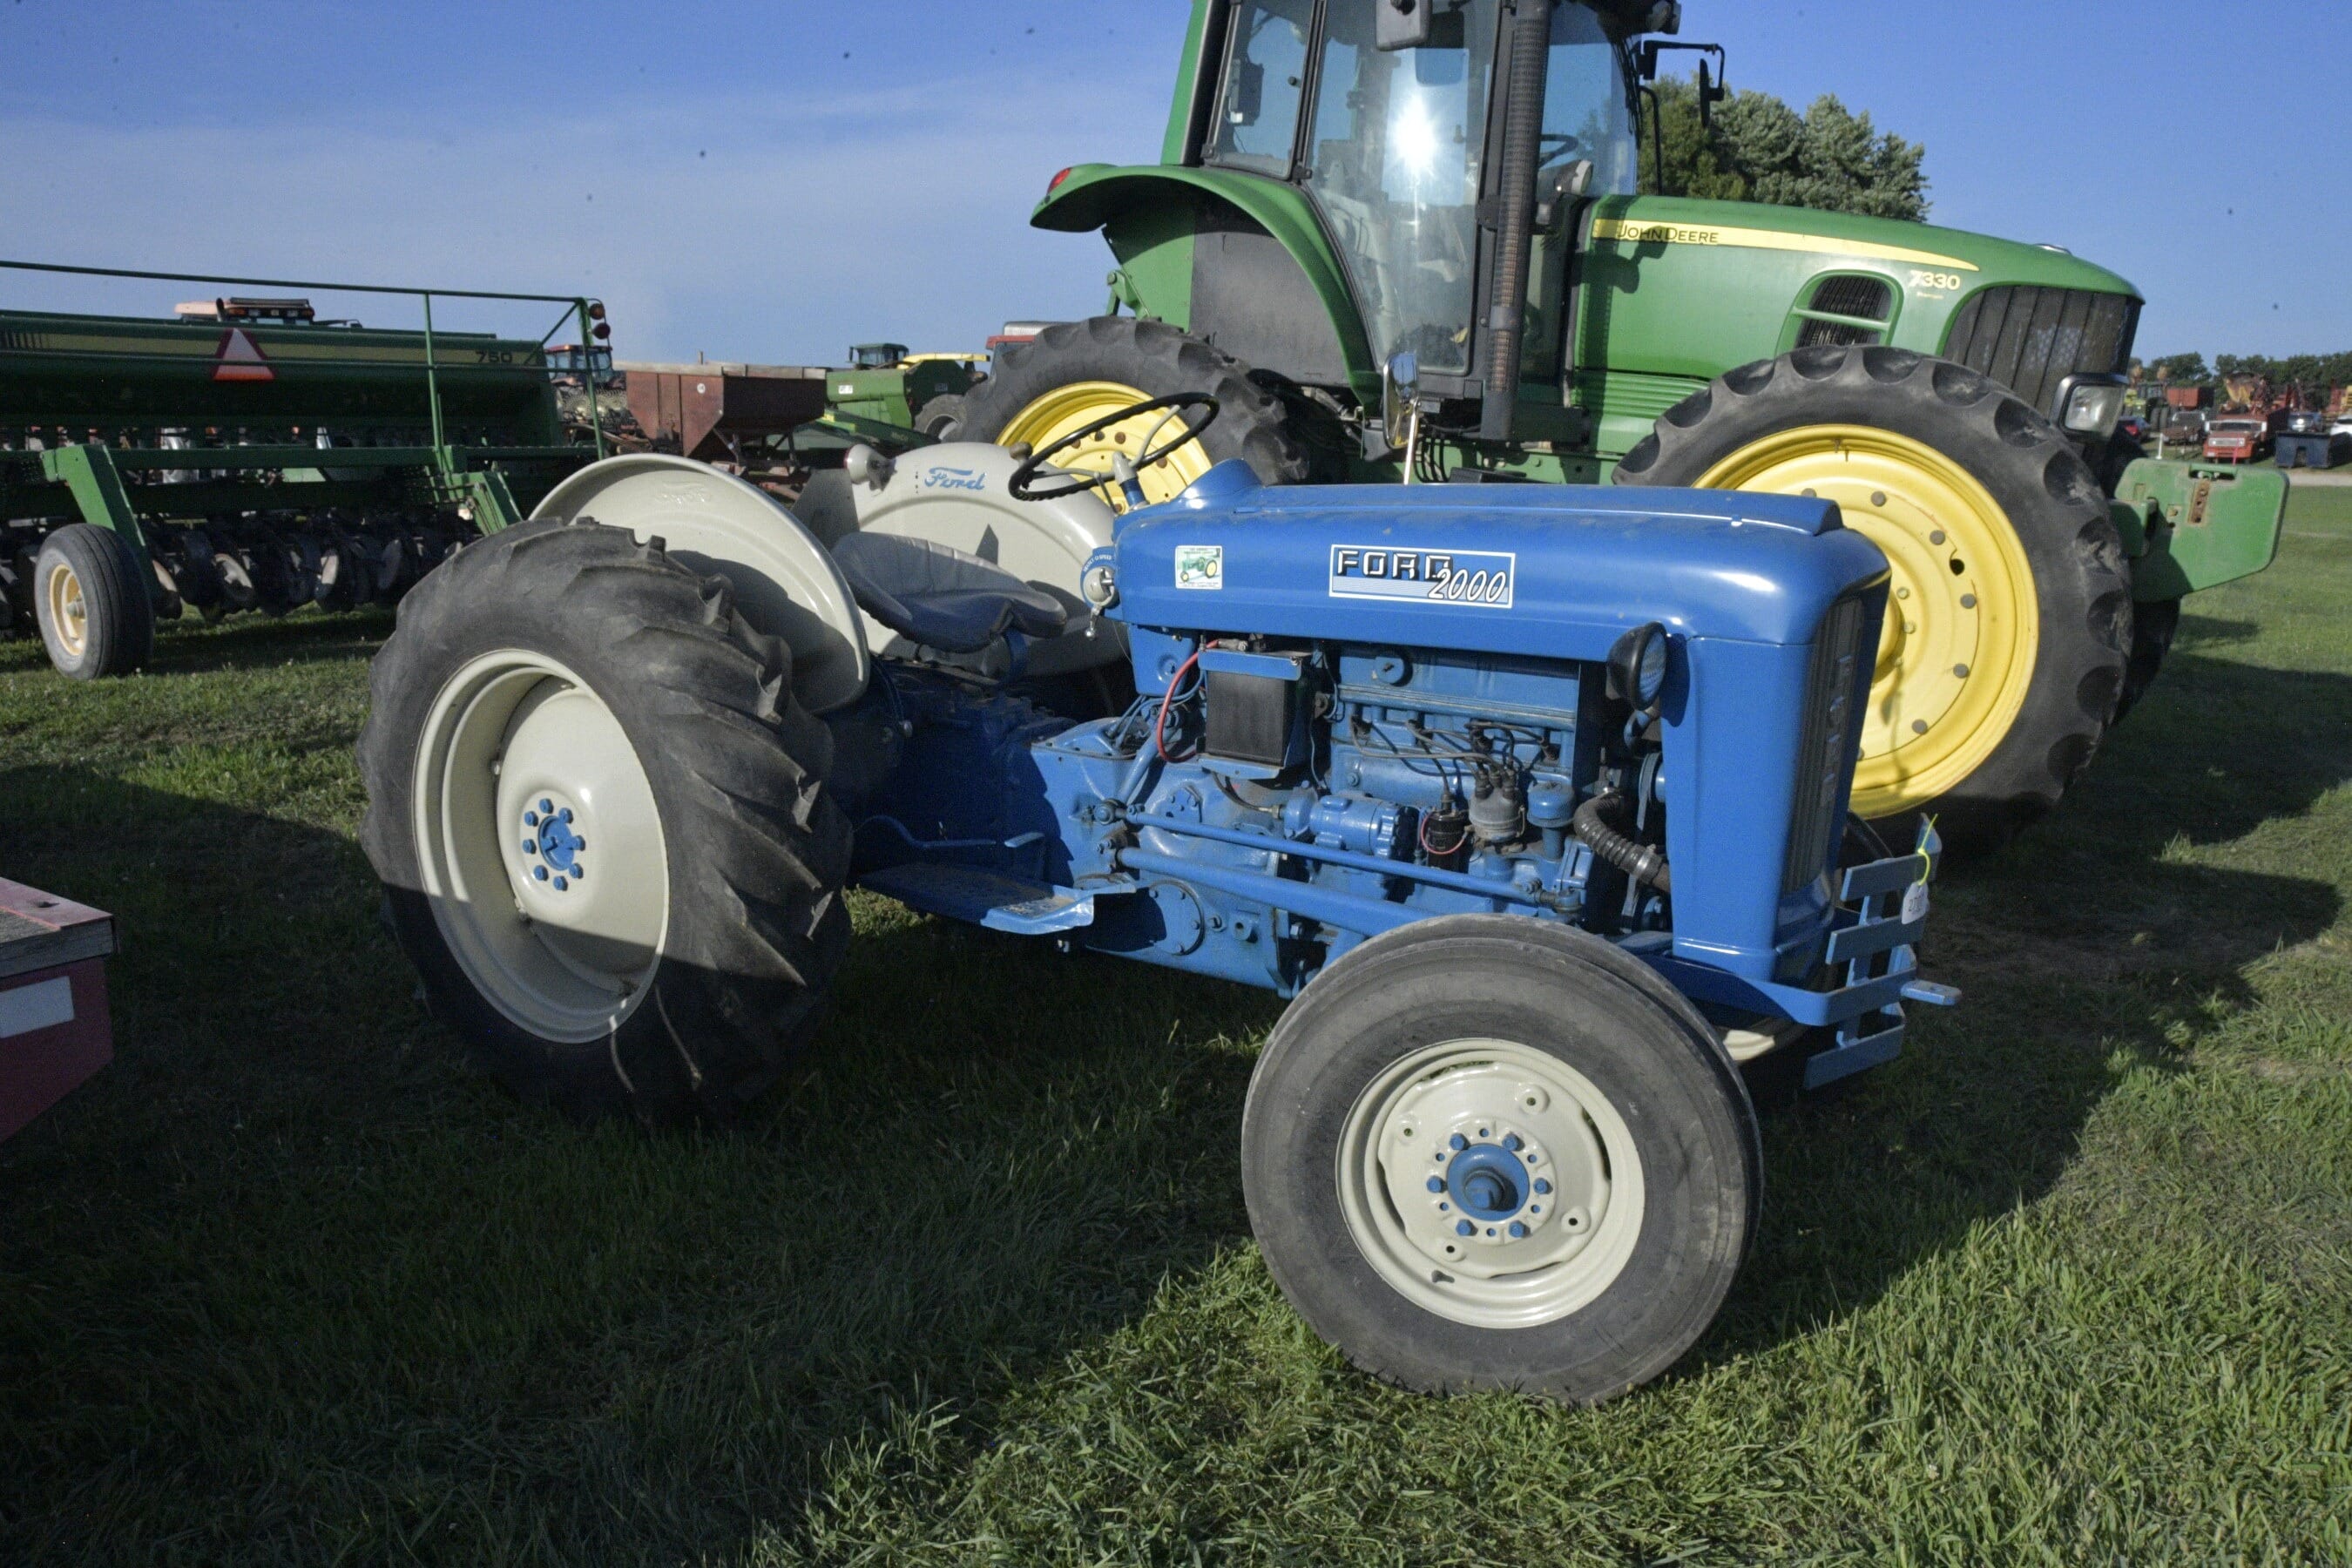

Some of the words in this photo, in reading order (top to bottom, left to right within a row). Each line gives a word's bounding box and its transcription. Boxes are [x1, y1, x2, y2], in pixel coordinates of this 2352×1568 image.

[1617, 224, 1663, 240] JOHN
[1665, 227, 1720, 243] DEERE
[1908, 269, 1961, 290] 7330
[924, 467, 985, 490] Ford
[1336, 550, 1453, 581] FORD
[1428, 569, 1506, 603] 2000
